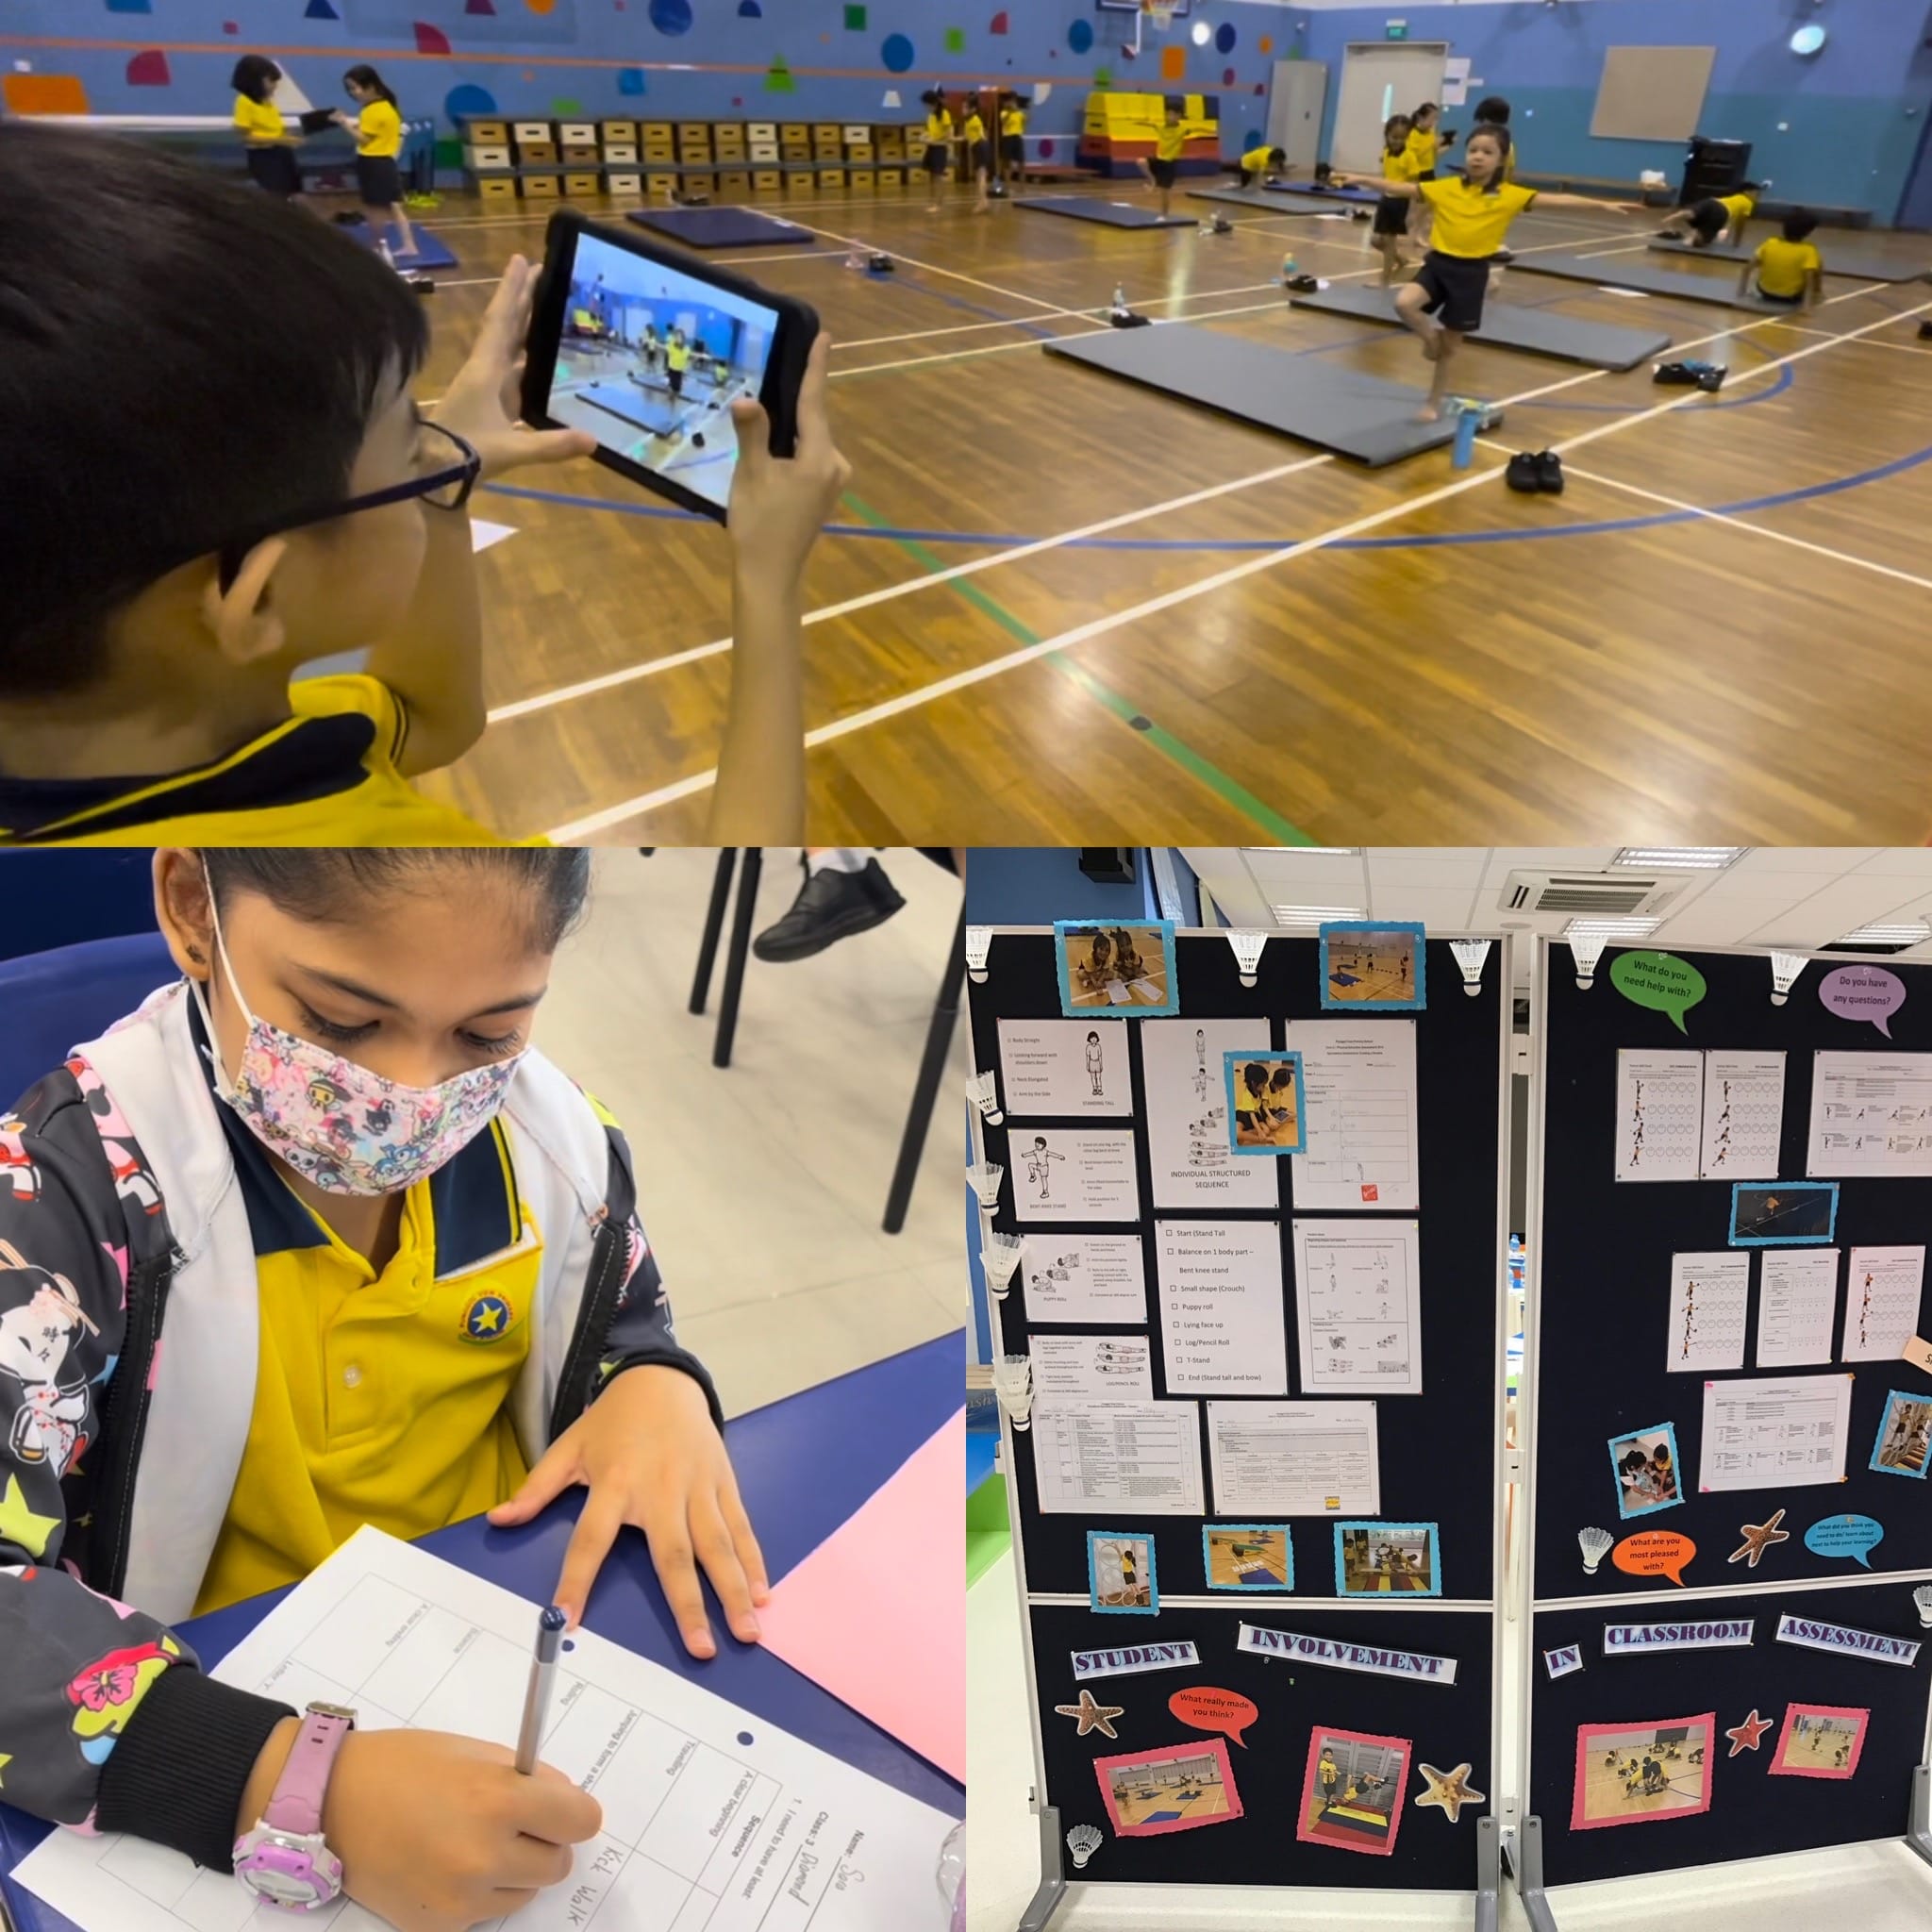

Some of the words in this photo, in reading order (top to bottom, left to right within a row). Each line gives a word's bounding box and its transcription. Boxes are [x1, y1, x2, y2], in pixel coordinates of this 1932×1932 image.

[1634, 959, 1657, 974] What
[1657, 966, 1670, 976] do
[1672, 971, 1688, 981] you
[1624, 975, 1645, 987] need
[1646, 980, 1665, 993] help
[1667, 986, 1691, 997] with?
[1840, 976, 1851, 985] Do
[1852, 978, 1867, 988] you
[1868, 977, 1888, 988] have
[1833, 995, 1847, 1005] any
[1849, 996, 1890, 1005] questions?
[1218, 1248, 1234, 1257] body
[1218, 1285, 1245, 1293] (Crouch)
[1666, 1538, 1681, 1546] you
[1650, 1549, 1679, 1559] pleased
[1642, 1562, 1664, 1571] with?
[1249, 1628, 1443, 1674] INVOLVEMENT
[1548, 1648, 1578, 1670] IN
[1607, 1622, 1752, 1644] CLASSROOM
[1781, 1619, 1917, 1657] ASSESSMENT
[1074, 1643, 1192, 1672] STUDENT
[1180, 1693, 1202, 1703] What
[1203, 1697, 1225, 1707] really
[1226, 1700, 1249, 1708] made
[610, 1708, 638, 1740] Jumping
[1209, 1710, 1235, 1719] think?
[607, 1740, 618, 1750] to
[595, 1748, 612, 1768] form
[665, 1740, 695, 1776] Travelling
[591, 1766, 599, 1774] a
[743, 1771, 754, 1780] A
[732, 1778, 749, 1800] clear
[708, 1797, 739, 1838] beginning
[775, 1813, 792, 1837] need
[808, 1810, 829, 1839] Class:
[731, 1814, 761, 1857] Sequence
[771, 1835, 782, 1845] to
[805, 1838, 815, 1846] 3
[844, 1829, 865, 1858] Name:
[590, 1845, 624, 1875] Kick
[759, 1844, 777, 1867] have
[753, 1866, 765, 1878] at
[788, 1851, 819, 1907] Diamond
